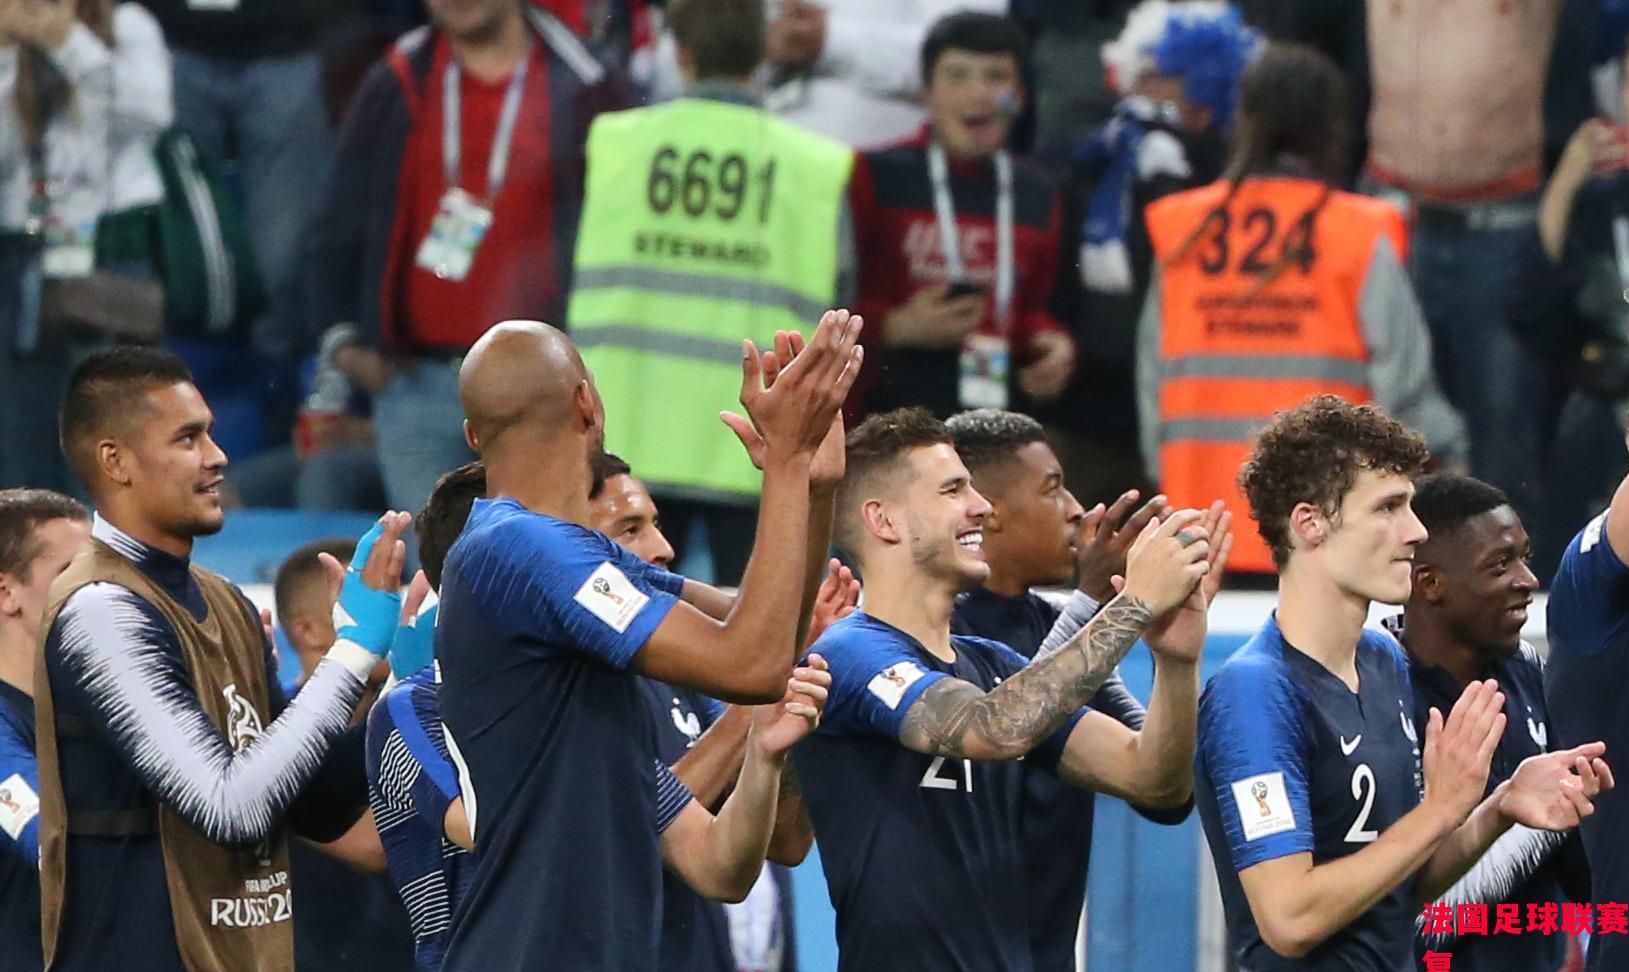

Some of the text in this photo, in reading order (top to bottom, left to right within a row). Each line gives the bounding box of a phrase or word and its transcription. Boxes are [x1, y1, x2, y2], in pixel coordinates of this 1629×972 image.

[648, 143, 776, 224] 6691
[1199, 206, 1317, 275] 324
[1343, 763, 1379, 843] 2
